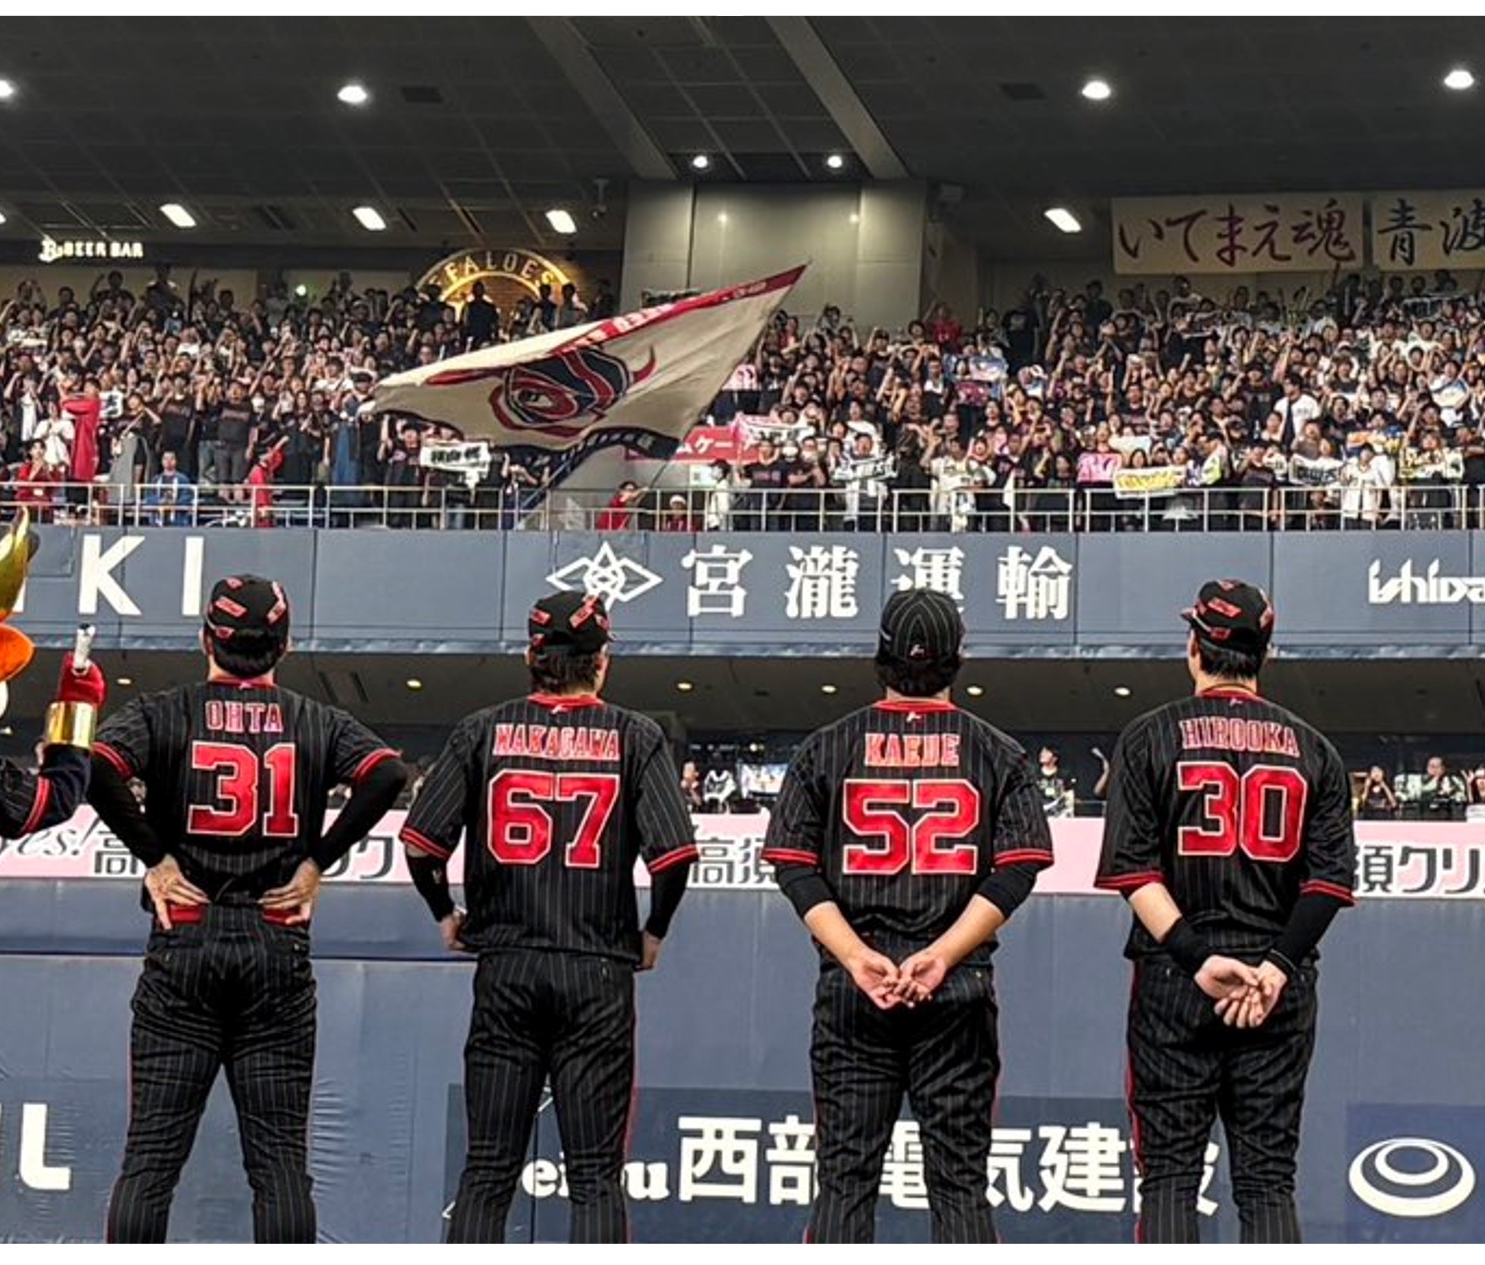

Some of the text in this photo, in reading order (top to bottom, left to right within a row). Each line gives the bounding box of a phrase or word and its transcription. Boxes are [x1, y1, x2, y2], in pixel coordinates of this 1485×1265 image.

[110, 242, 144, 258] BAR
[1119, 199, 1359, 267] いてまえ魂
[681, 544, 1074, 620] 宮瀧運輸
[205, 699, 284, 734] OHTA
[492, 723, 621, 761] NAKAGAWA
[1178, 717, 1300, 758] HIROOKA
[187, 740, 299, 838] 31
[487, 768, 621, 869] 67
[1177, 760, 1310, 863] 30
[843, 778, 980, 875] 52
